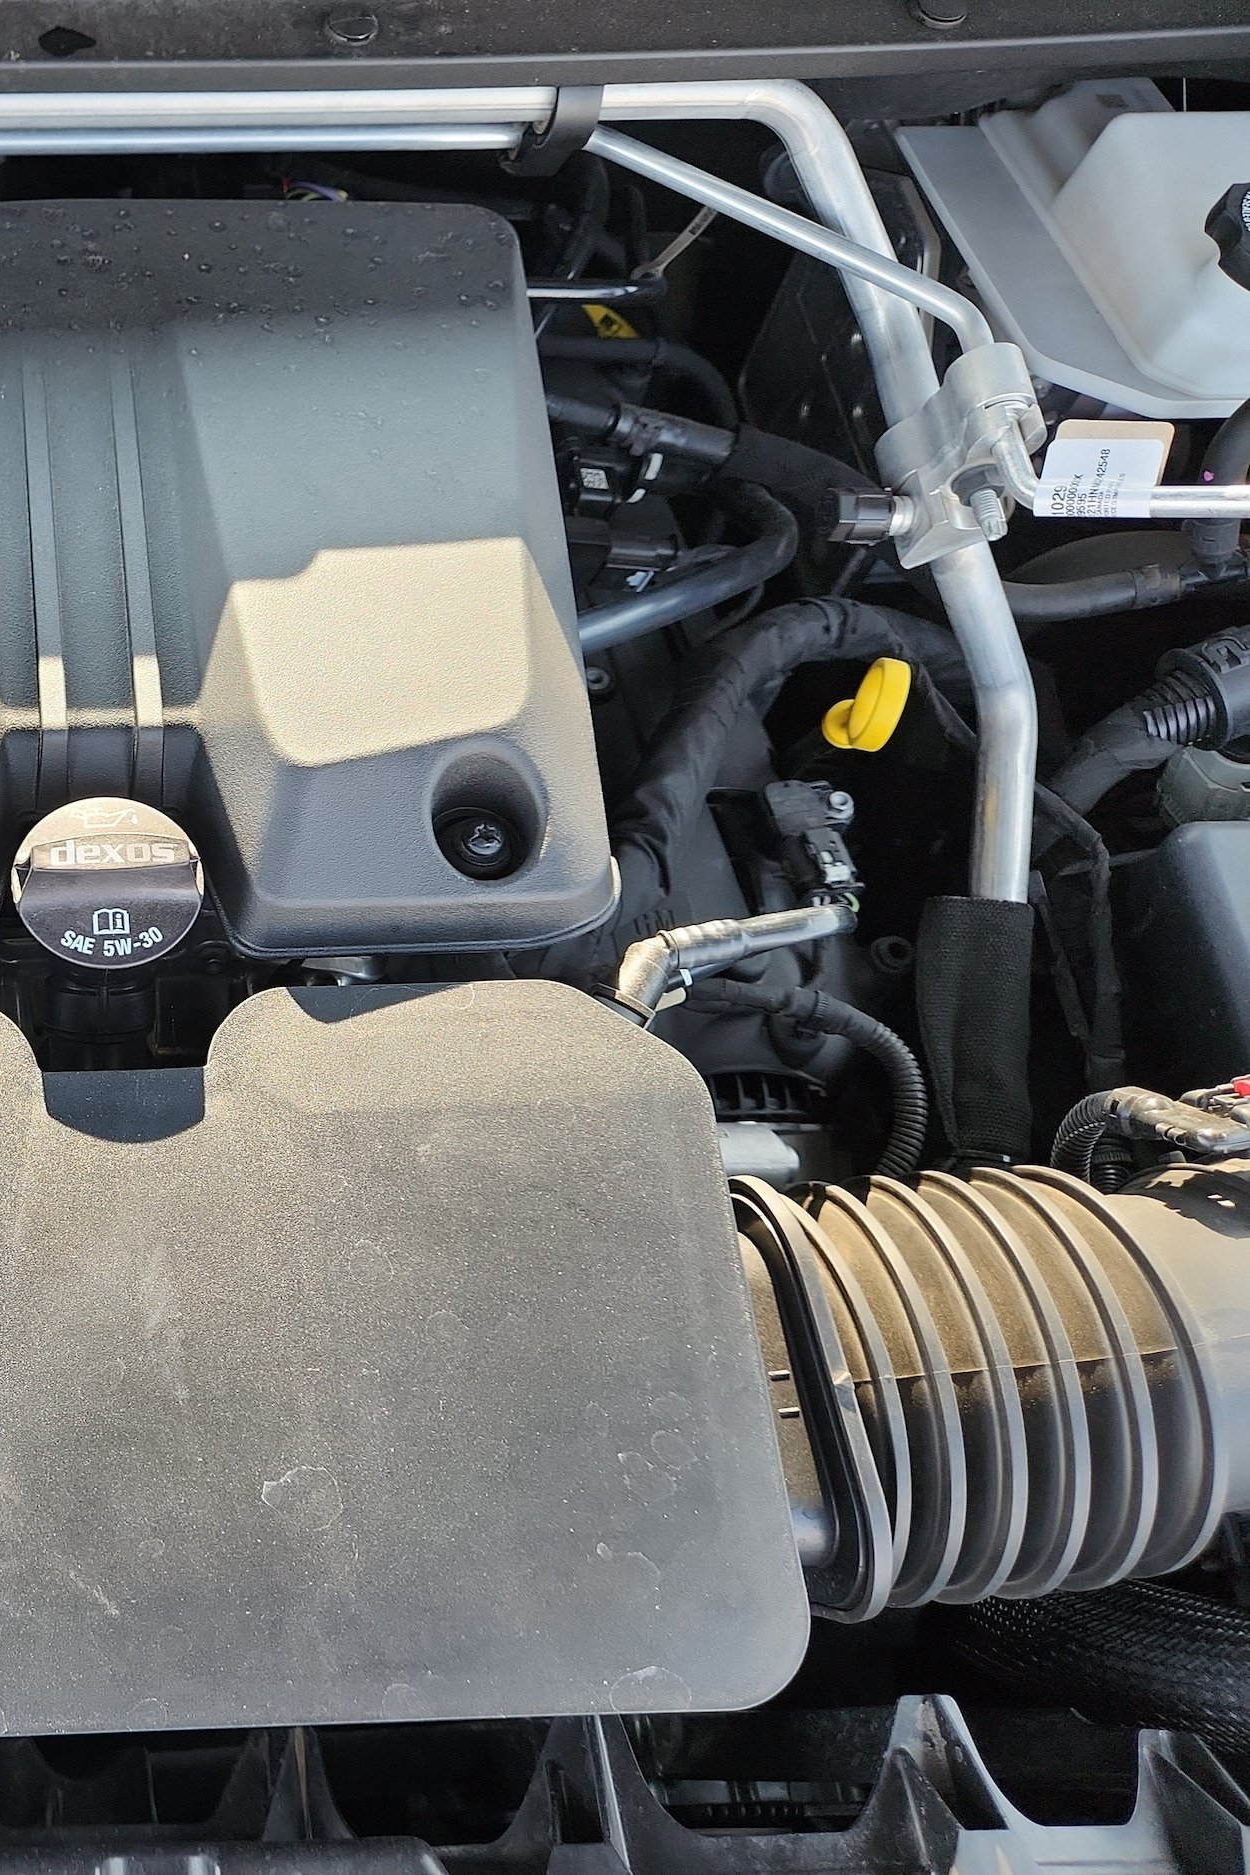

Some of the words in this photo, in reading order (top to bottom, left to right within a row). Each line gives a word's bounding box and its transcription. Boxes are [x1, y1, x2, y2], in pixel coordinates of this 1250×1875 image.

[50, 839, 178, 866] dexos
[60, 930, 96, 955] SAE
[102, 926, 163, 957] 5W-30
